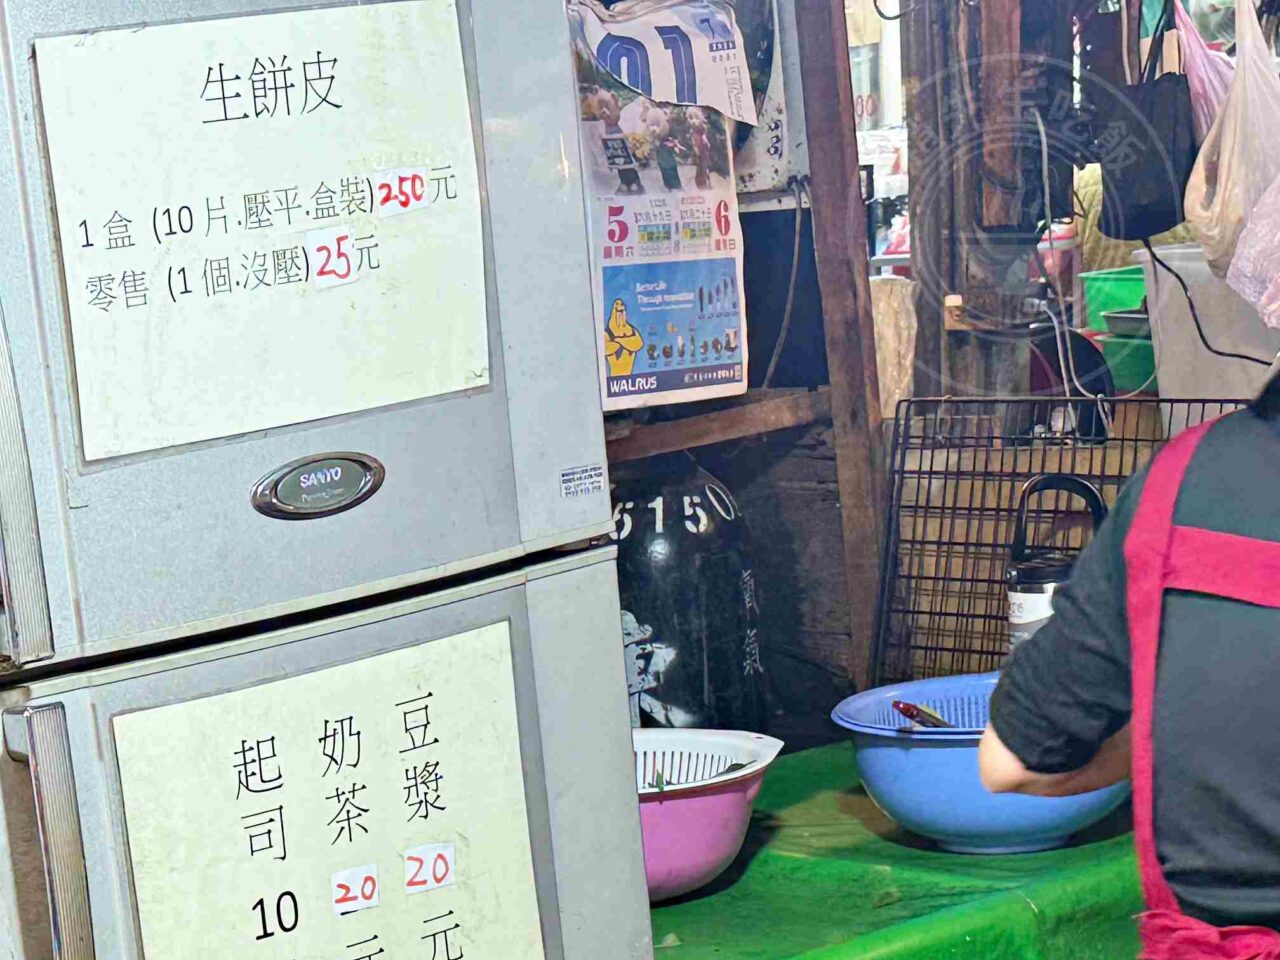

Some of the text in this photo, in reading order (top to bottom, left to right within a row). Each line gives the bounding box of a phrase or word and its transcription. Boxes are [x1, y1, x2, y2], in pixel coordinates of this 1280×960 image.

[201, 51, 343, 123] 生餅皮
[608, 206, 629, 243] 5
[715, 200, 730, 236] 6
[86, 270, 149, 312] 零售
[610, 376, 657, 393] WALRUS
[300, 466, 341, 488] SANYO
[395, 692, 447, 822] 豆漿
[233, 736, 287, 861] 起司
[319, 716, 370, 846] 奶茶
[334, 876, 377, 904] 20
[406, 854, 450, 887] 20
[251, 891, 299, 940] 10
